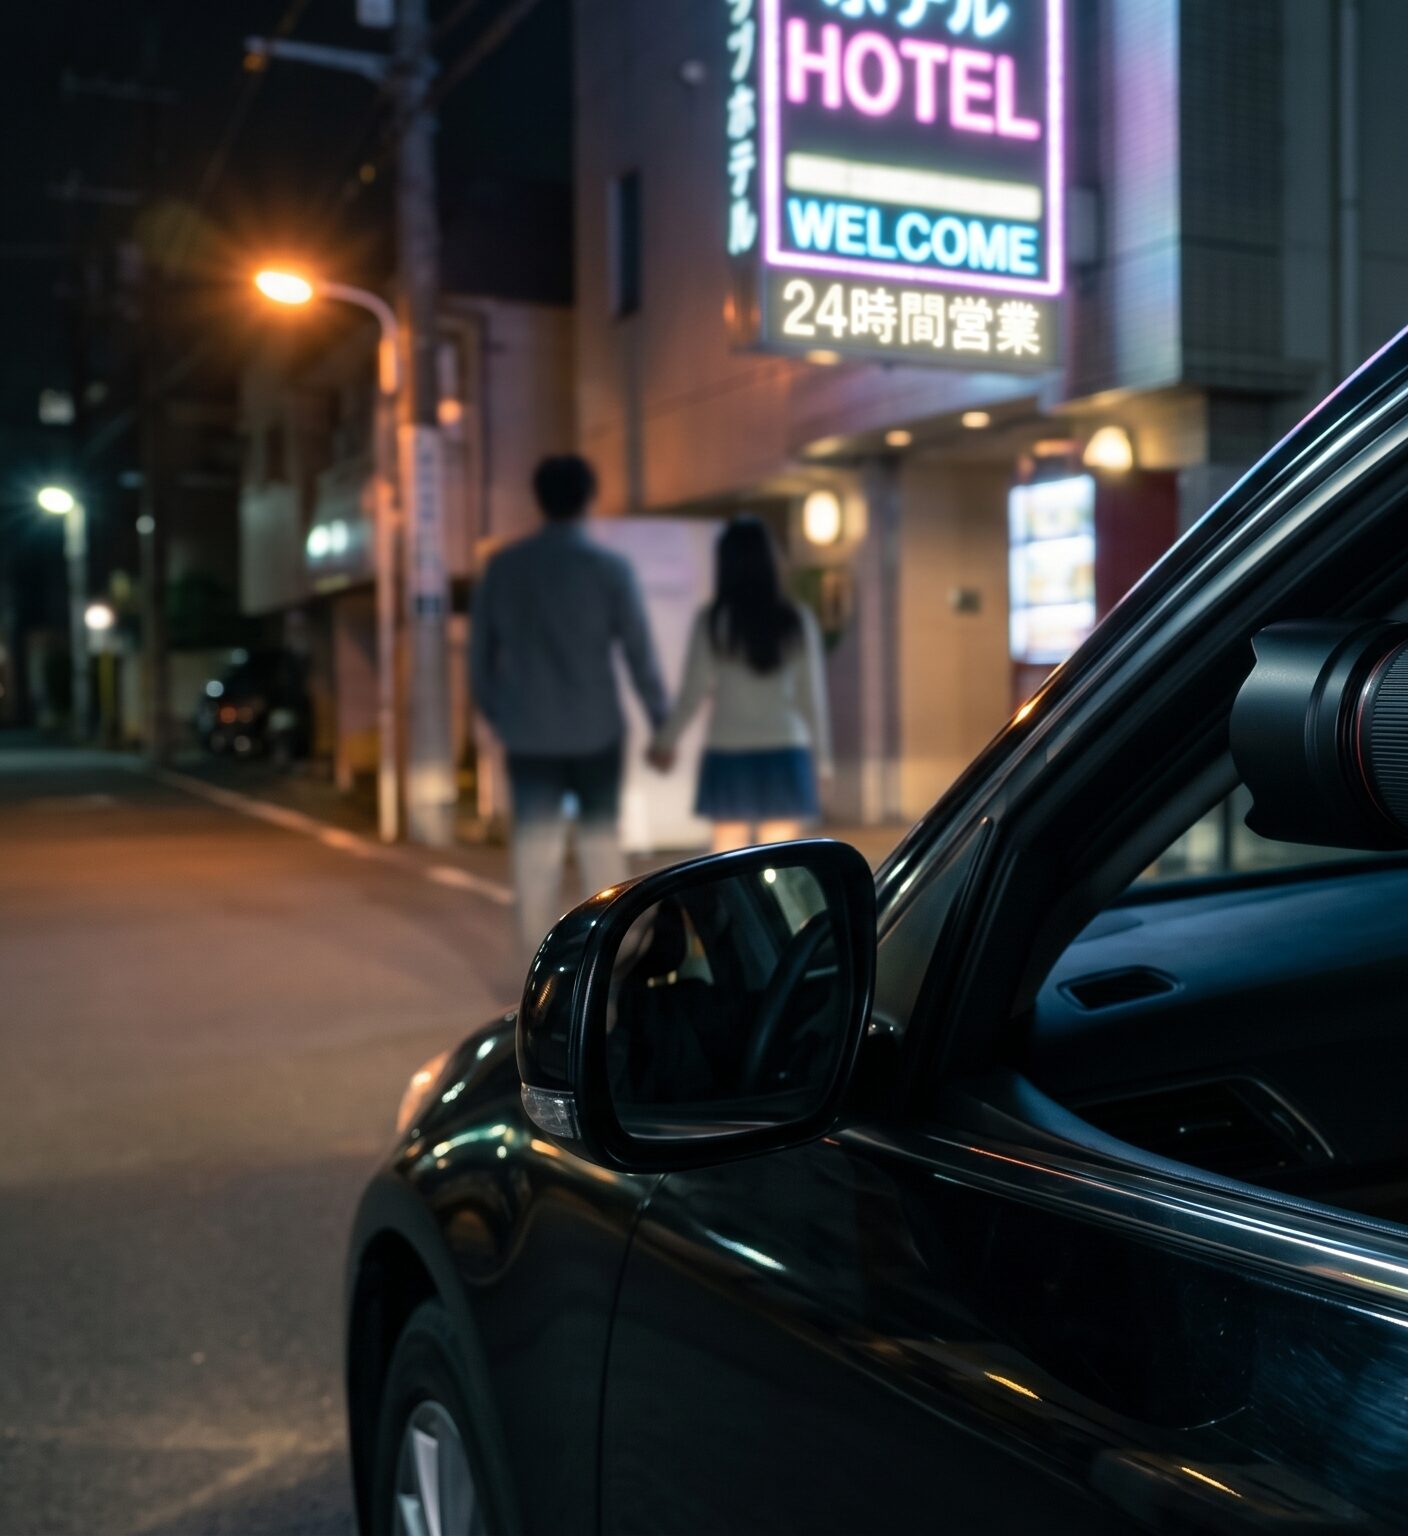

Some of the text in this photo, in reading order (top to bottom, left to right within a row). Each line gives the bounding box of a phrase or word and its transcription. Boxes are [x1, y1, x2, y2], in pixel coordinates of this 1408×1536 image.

[785, 16, 1042, 142] HOTEL
[787, 197, 1040, 277] WELCOME
[782, 278, 1042, 356] 24時間営業
